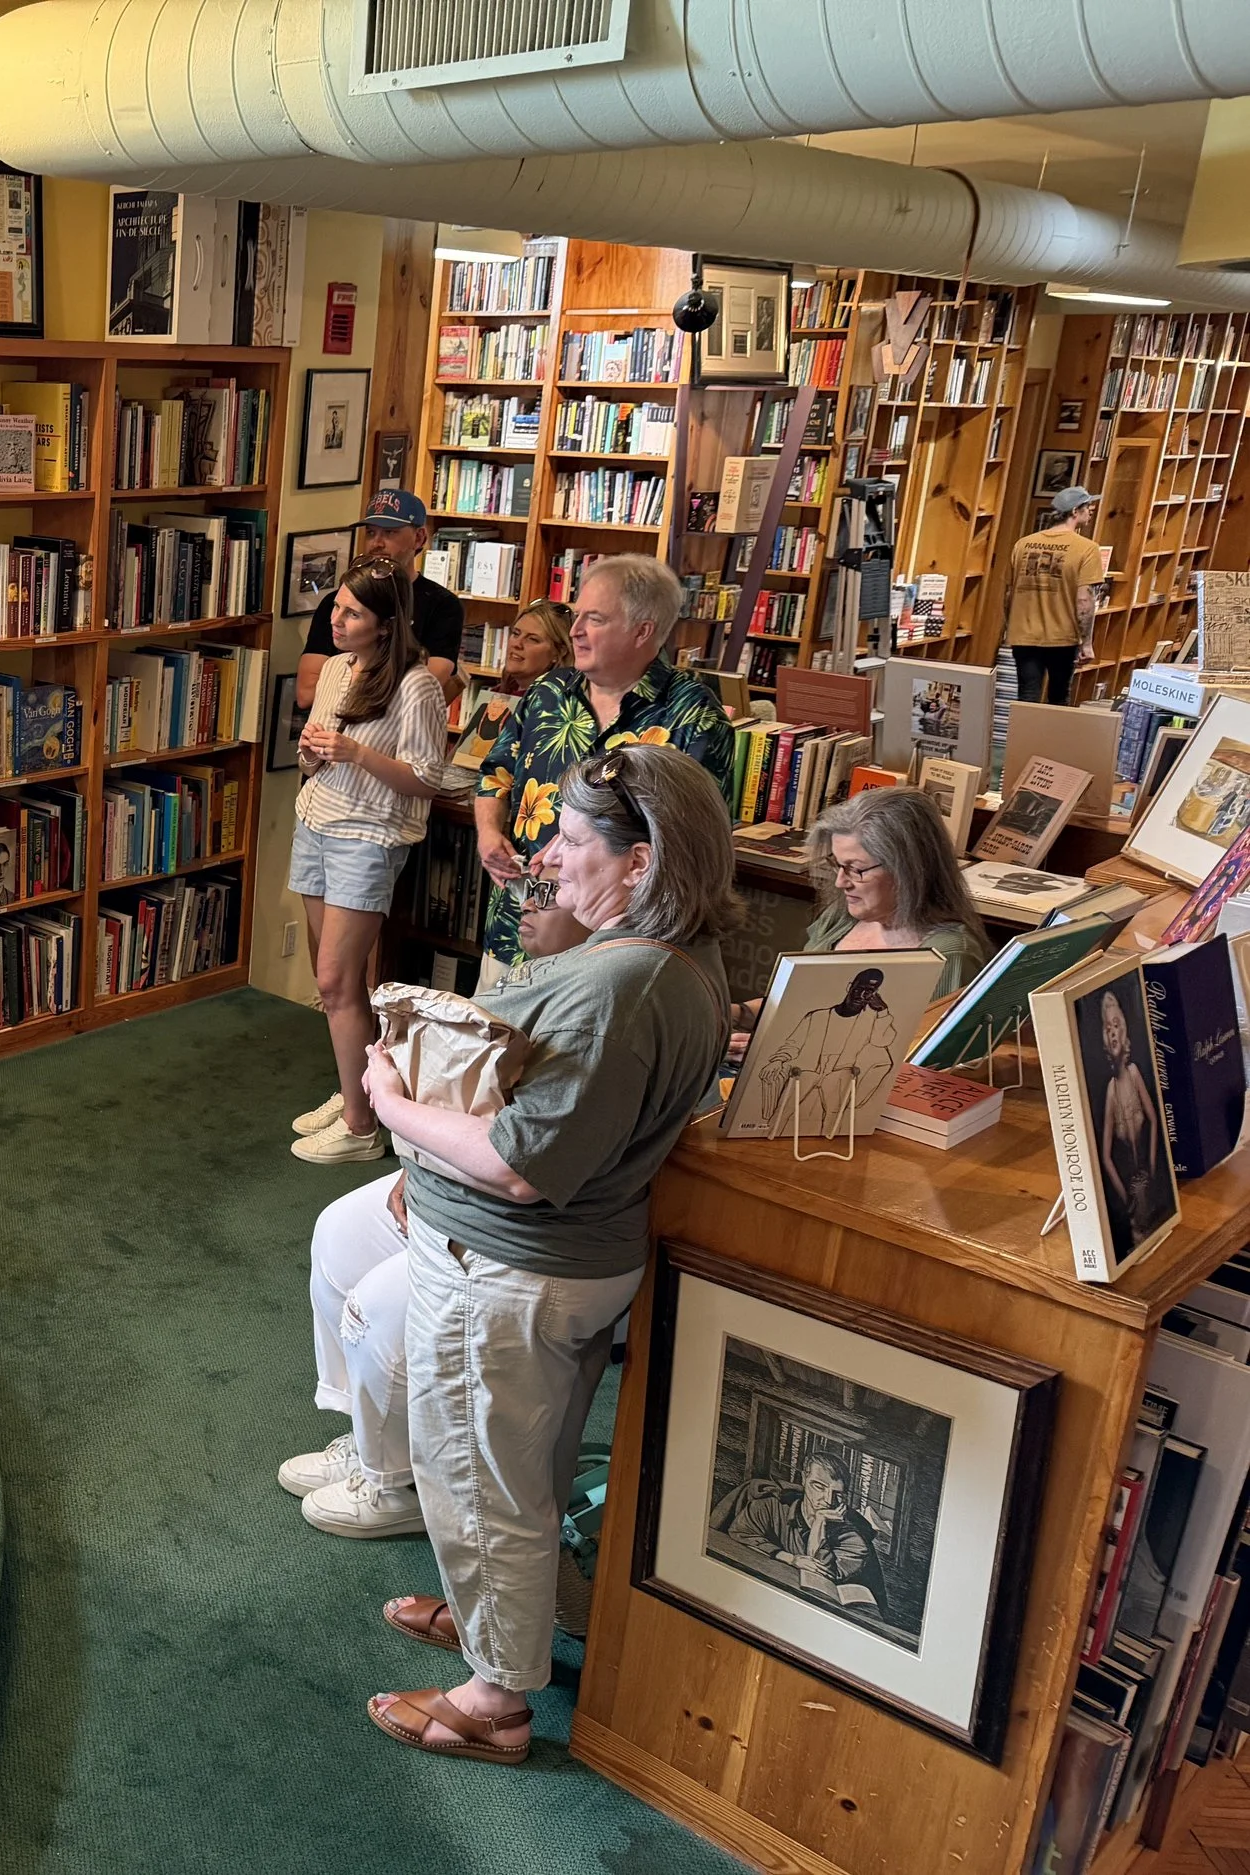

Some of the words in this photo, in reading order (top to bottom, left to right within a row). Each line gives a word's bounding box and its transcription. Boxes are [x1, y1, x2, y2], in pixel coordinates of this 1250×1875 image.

[116, 214, 168, 227] ARCHITECTURE
[13, 416, 35, 424] Weather
[36, 423, 54, 433] TISTS
[36, 438, 50, 447] ARS
[13, 475, 32, 484] Laing
[62, 568, 72, 616] Leonardo
[1132, 677, 1196, 704] MOLESKINE
[23, 708, 38, 719] Van
[38, 705, 62, 721] Gogh
[67, 693, 76, 718] VAN
[66, 721, 75, 758] GOGH
[756, 737, 764, 753] NINTH
[753, 754, 762, 773] STREET
[792, 754, 802, 789] BASQUIAT
[1145, 980, 1161, 1034] Ralph
[1193, 1040, 1214, 1063] Ralph
[1215, 1027, 1236, 1049] Lauren
[1151, 1034, 1174, 1091] Lauren
[903, 1077, 958, 1102] NEEL
[930, 1084, 984, 1114] ALICE
[1052, 1064, 1073, 1121] MARILYN
[1164, 1103, 1178, 1143] CATWALK
[1061, 1124, 1084, 1184] MONROE
[1070, 1188, 1088, 1213] 100
